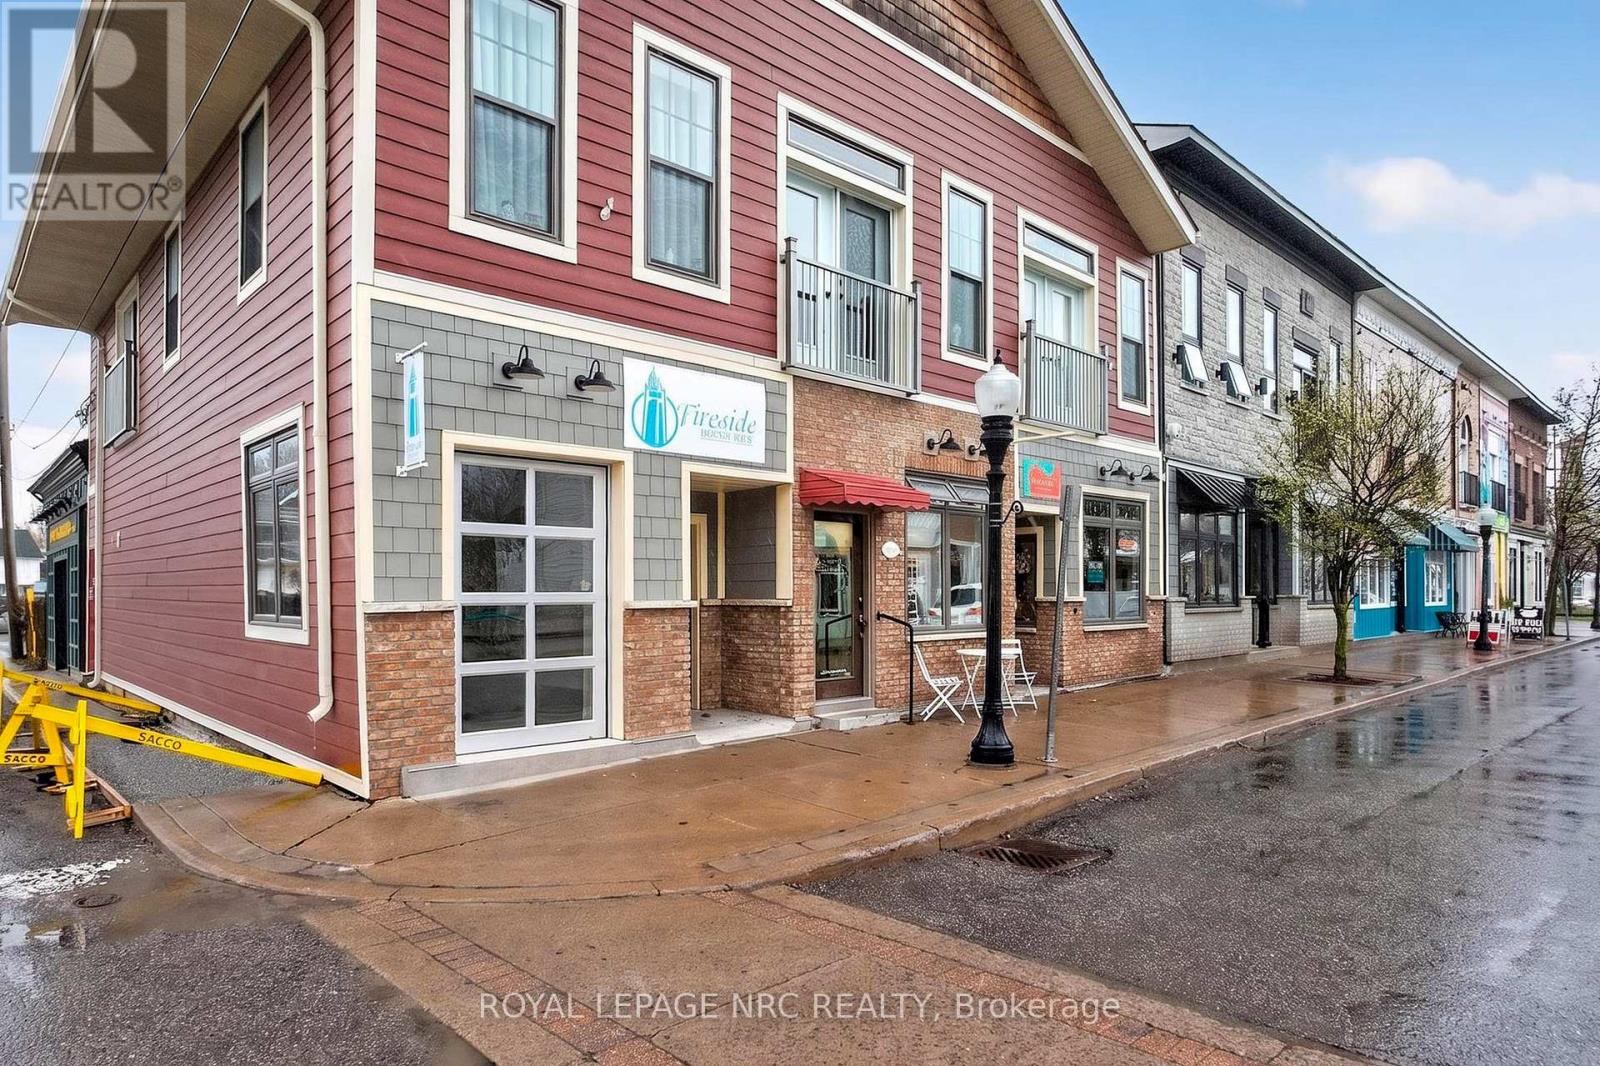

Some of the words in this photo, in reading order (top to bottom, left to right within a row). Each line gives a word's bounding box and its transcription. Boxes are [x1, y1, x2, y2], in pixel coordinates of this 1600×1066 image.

[677, 403, 757, 434] Fireside
[138, 732, 182, 750] SACCO
[4, 755, 46, 764] SACCO
